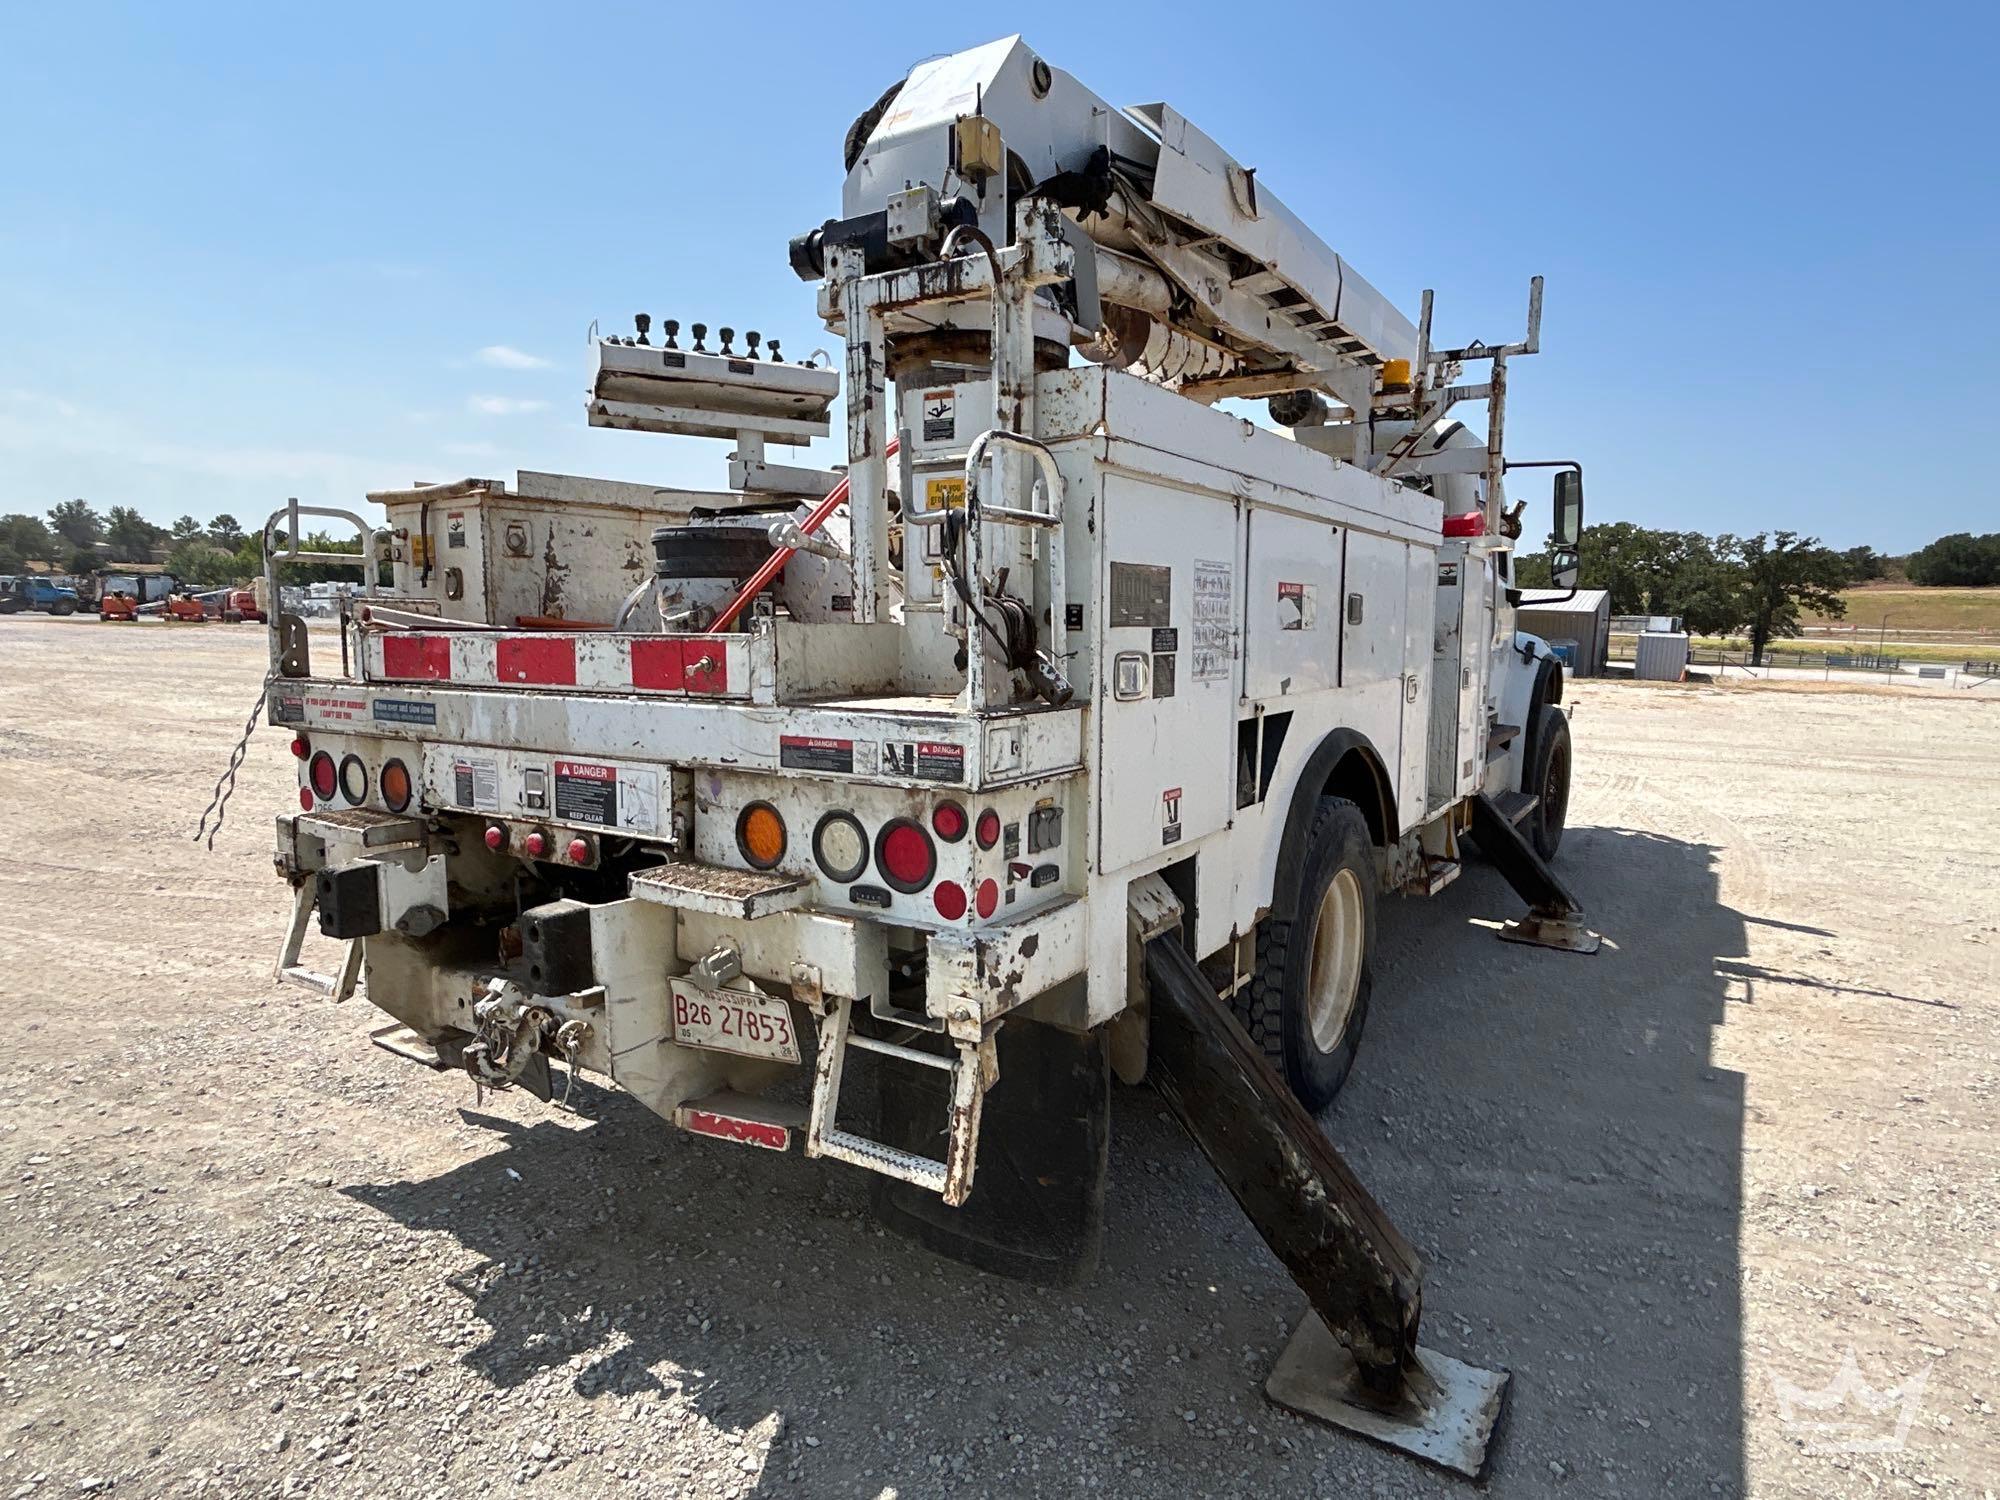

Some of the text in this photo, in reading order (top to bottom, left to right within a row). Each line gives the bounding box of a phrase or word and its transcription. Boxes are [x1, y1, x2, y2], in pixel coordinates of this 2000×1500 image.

[573, 765, 607, 777] DANGER
[569, 811, 604, 823] KEEP CLEAR
[676, 994, 790, 1045] B26 27853
